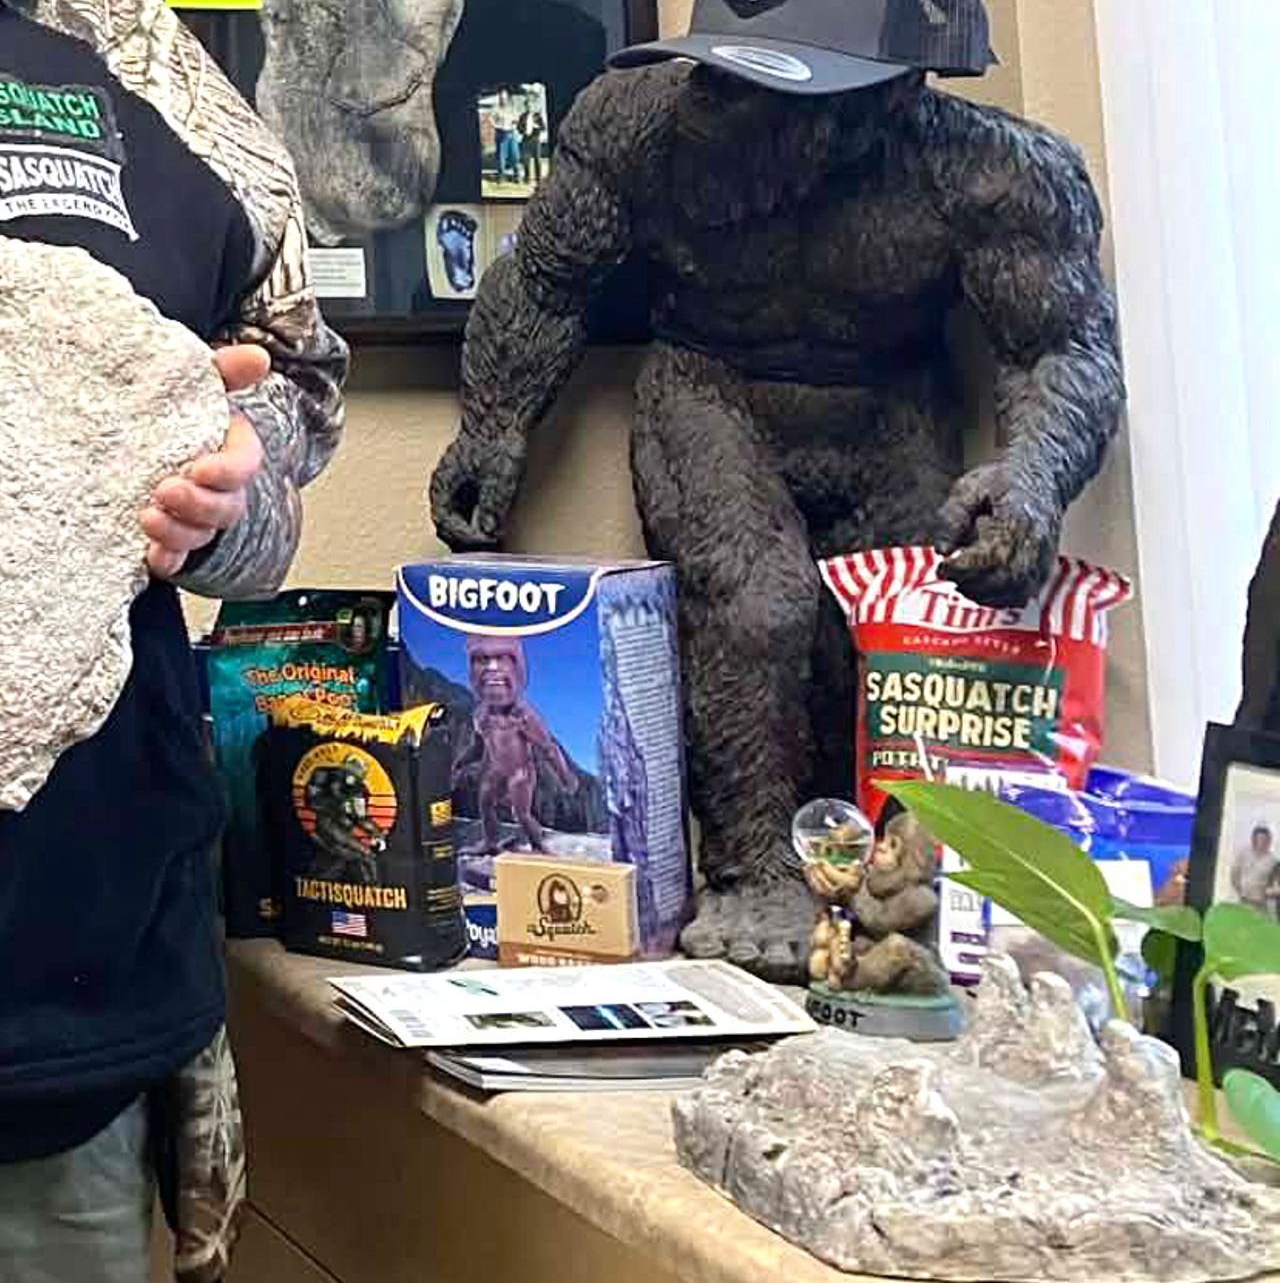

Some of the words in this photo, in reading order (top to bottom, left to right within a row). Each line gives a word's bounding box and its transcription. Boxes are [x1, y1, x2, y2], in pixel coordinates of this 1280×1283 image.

[5, 198, 38, 213] THE
[428, 574, 566, 614] BIGFOOT
[921, 589, 1023, 628] Tims
[282, 661, 355, 687] Original
[866, 671, 1058, 718] SASQUATCH
[880, 705, 1032, 749] SURPRISE
[295, 877, 408, 909] TACTISQUATCH
